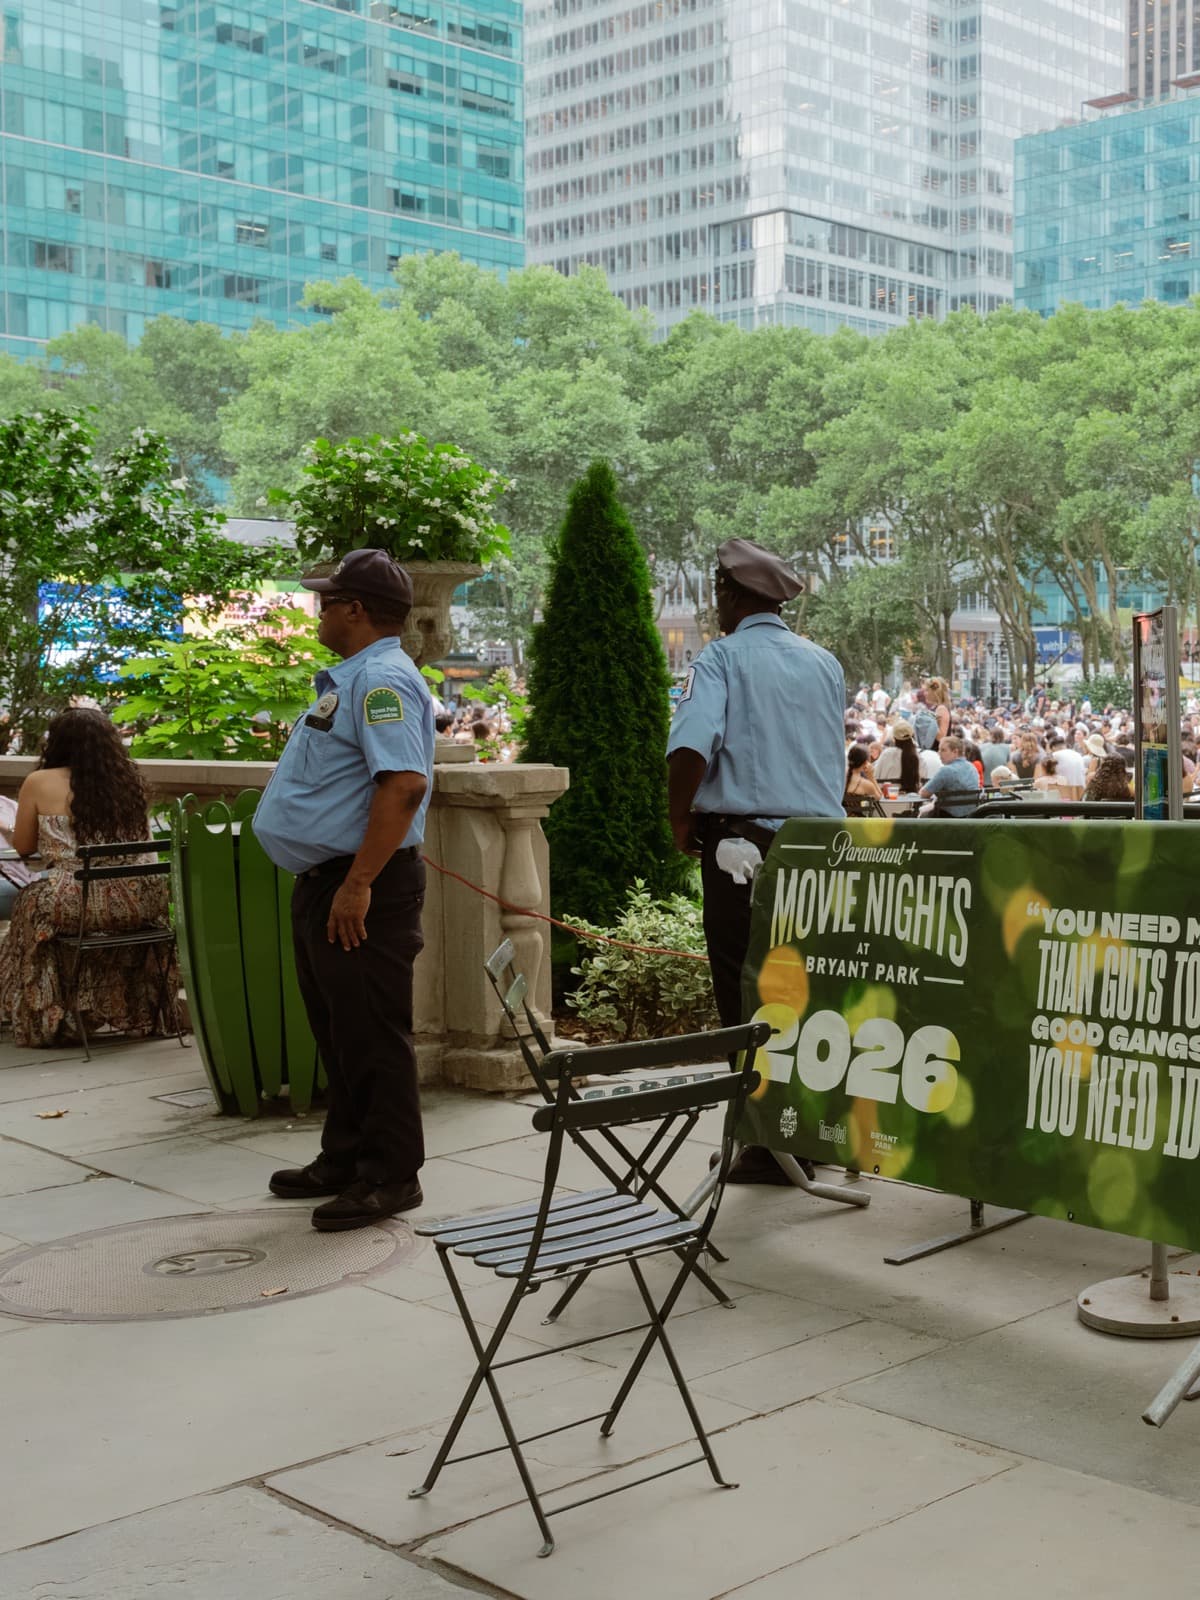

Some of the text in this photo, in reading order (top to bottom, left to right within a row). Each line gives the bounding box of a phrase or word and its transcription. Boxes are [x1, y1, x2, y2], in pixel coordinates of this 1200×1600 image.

[828, 830, 919, 866] Paramount+
[770, 868, 973, 968] MOVIE NIGHTS
[1100, 912, 1180, 944] NEED
[856, 941, 870, 956] AT
[805, 956, 920, 986] BRYANT PARK
[1036, 940, 1095, 1016] THAN
[1099, 946, 1166, 1025] GUTS
[1031, 1015, 1104, 1048] GOOD
[747, 1003, 961, 1113] 2026
[1025, 1044, 1082, 1135] YOU
[1084, 1053, 1157, 1153] NEED
[870, 1131, 898, 1144] BRYANT
